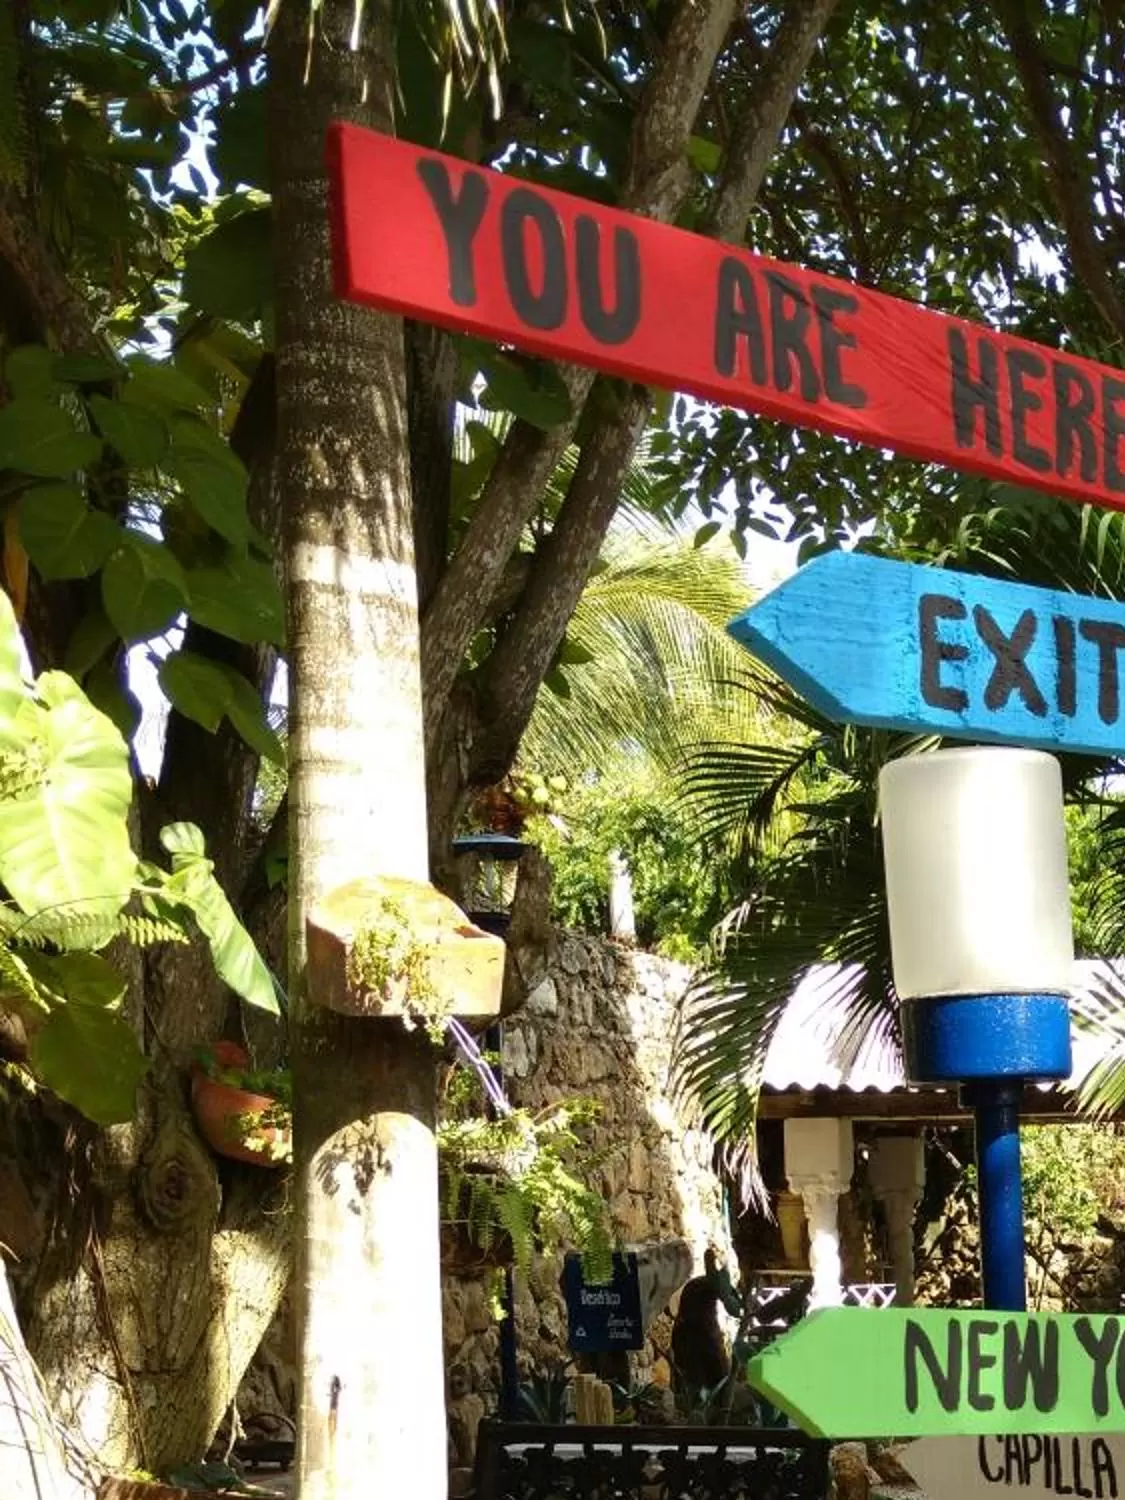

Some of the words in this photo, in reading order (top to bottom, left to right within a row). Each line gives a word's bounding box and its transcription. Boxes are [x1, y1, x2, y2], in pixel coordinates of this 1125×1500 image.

[416, 158, 642, 346] YOU
[713, 256, 867, 409] ARE
[904, 1317, 1060, 1414] NEW
[978, 1434, 1118, 1499] CAPILLA
